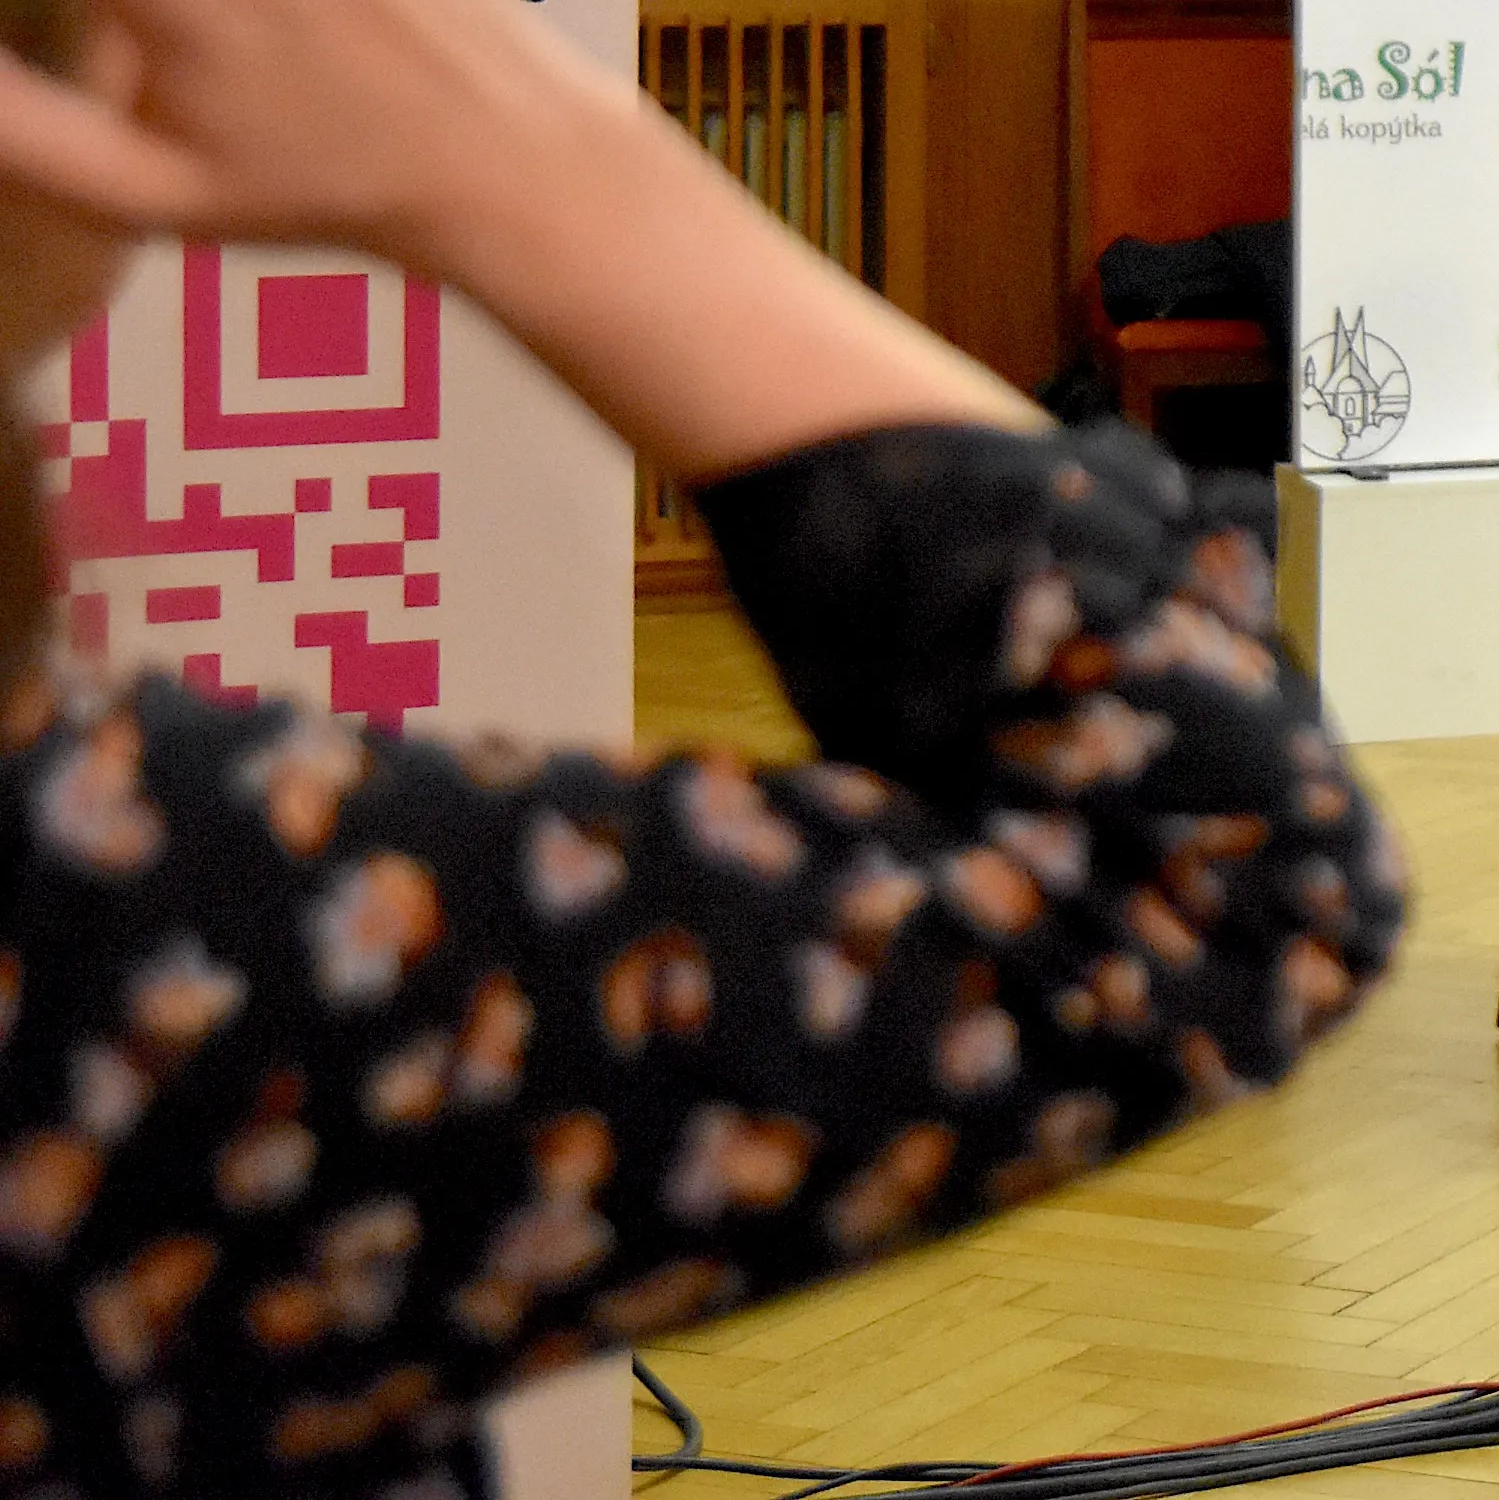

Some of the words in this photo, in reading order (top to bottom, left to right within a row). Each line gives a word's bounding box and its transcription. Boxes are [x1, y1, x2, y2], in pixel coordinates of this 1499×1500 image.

[1302, 64, 1364, 101] na
[1376, 40, 1466, 103] Sól
[1340, 113, 1442, 145] kopýtka
